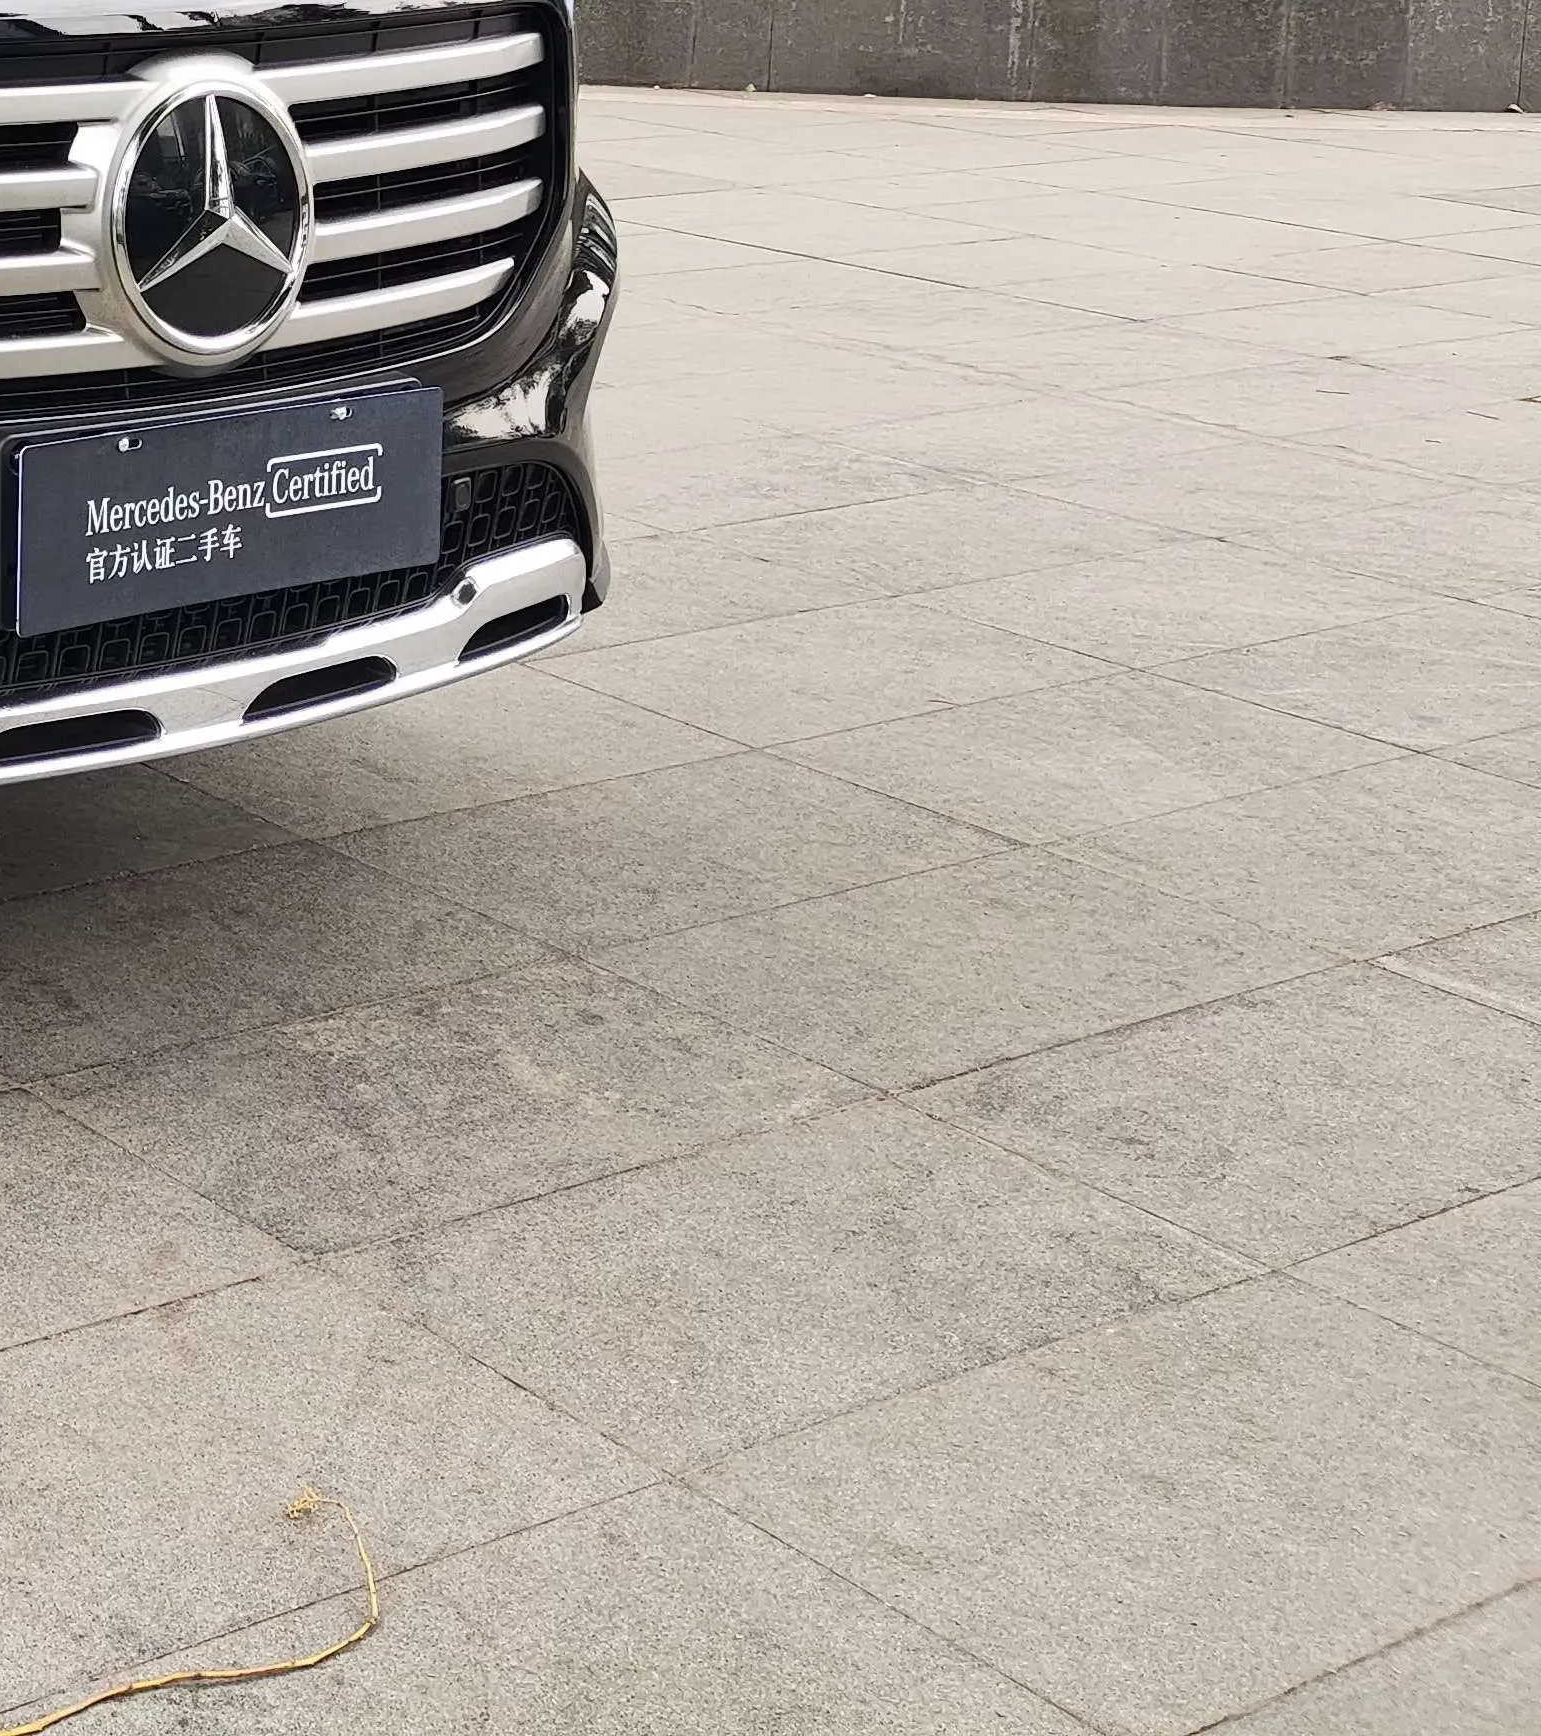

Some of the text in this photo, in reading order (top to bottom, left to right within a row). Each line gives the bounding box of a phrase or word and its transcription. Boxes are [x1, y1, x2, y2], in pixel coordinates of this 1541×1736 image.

[85, 455, 376, 537] Mercedes-Benz Certified
[85, 523, 243, 584] 官方认证二手车
